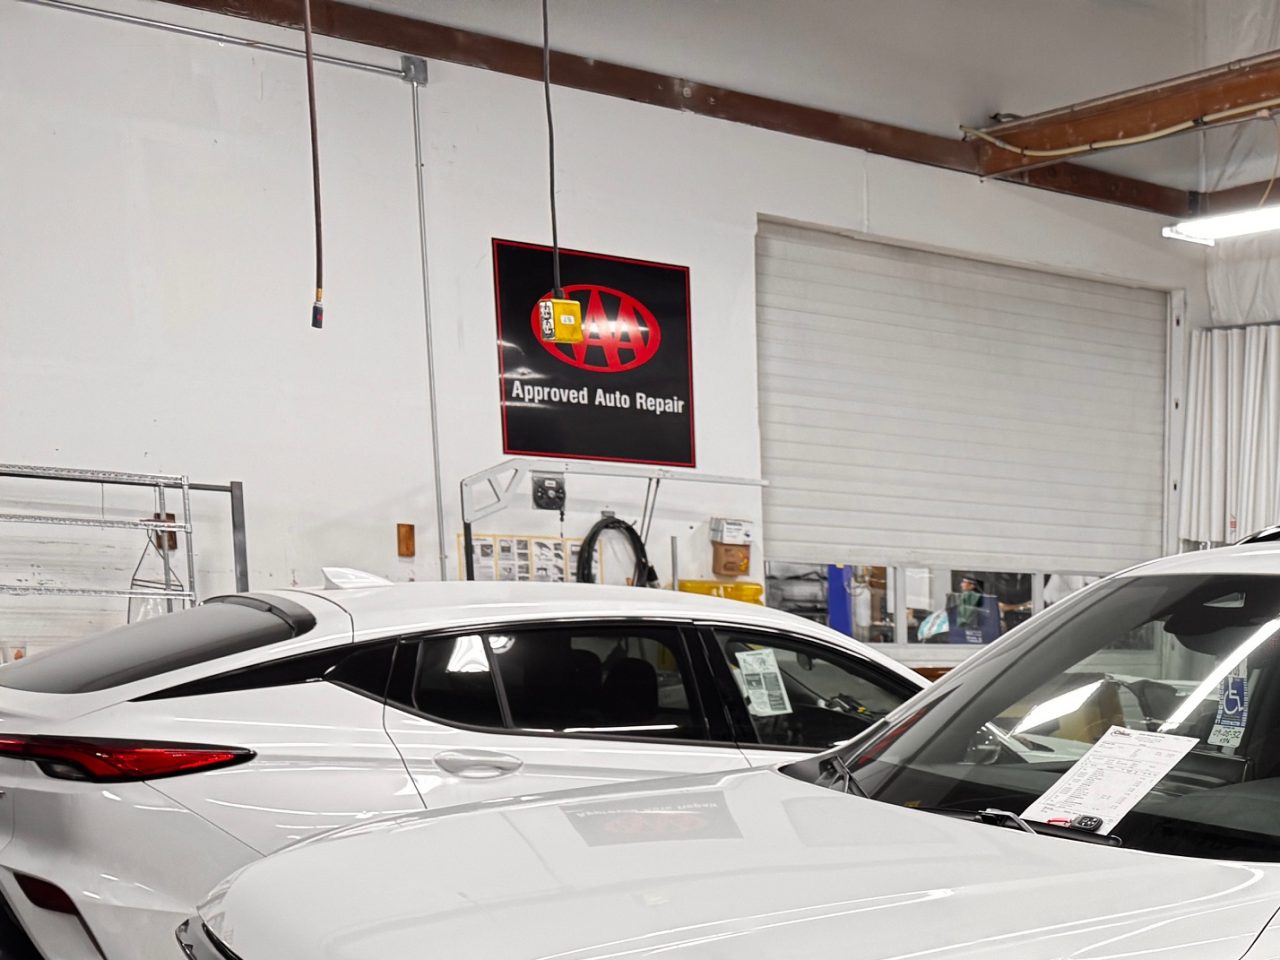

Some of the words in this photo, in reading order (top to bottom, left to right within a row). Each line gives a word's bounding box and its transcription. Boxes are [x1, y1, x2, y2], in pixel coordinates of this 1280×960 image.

[511, 380, 588, 405] Approved
[594, 388, 630, 408] Auto
[635, 392, 685, 415] Repair
